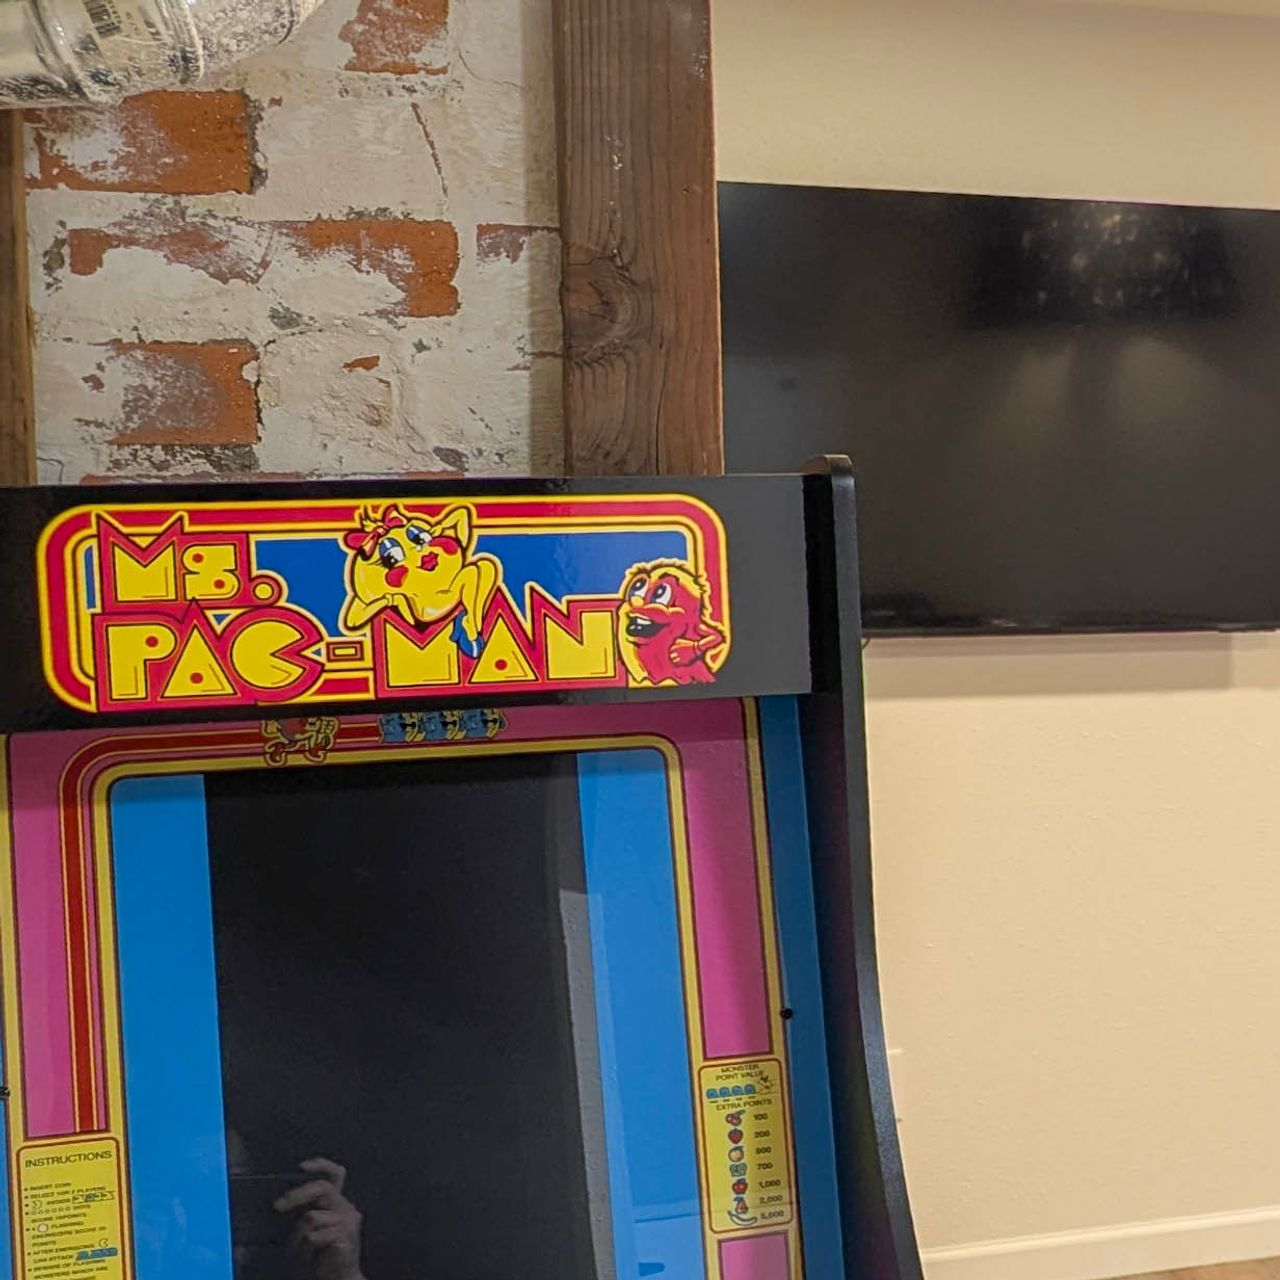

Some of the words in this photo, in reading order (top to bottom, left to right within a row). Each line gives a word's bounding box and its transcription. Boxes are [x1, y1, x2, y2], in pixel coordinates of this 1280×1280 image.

[99, 592, 624, 706] PAC-MAN
[25, 1150, 113, 1168] INSTRUCTIONS
[756, 1162, 773, 1170] 700
